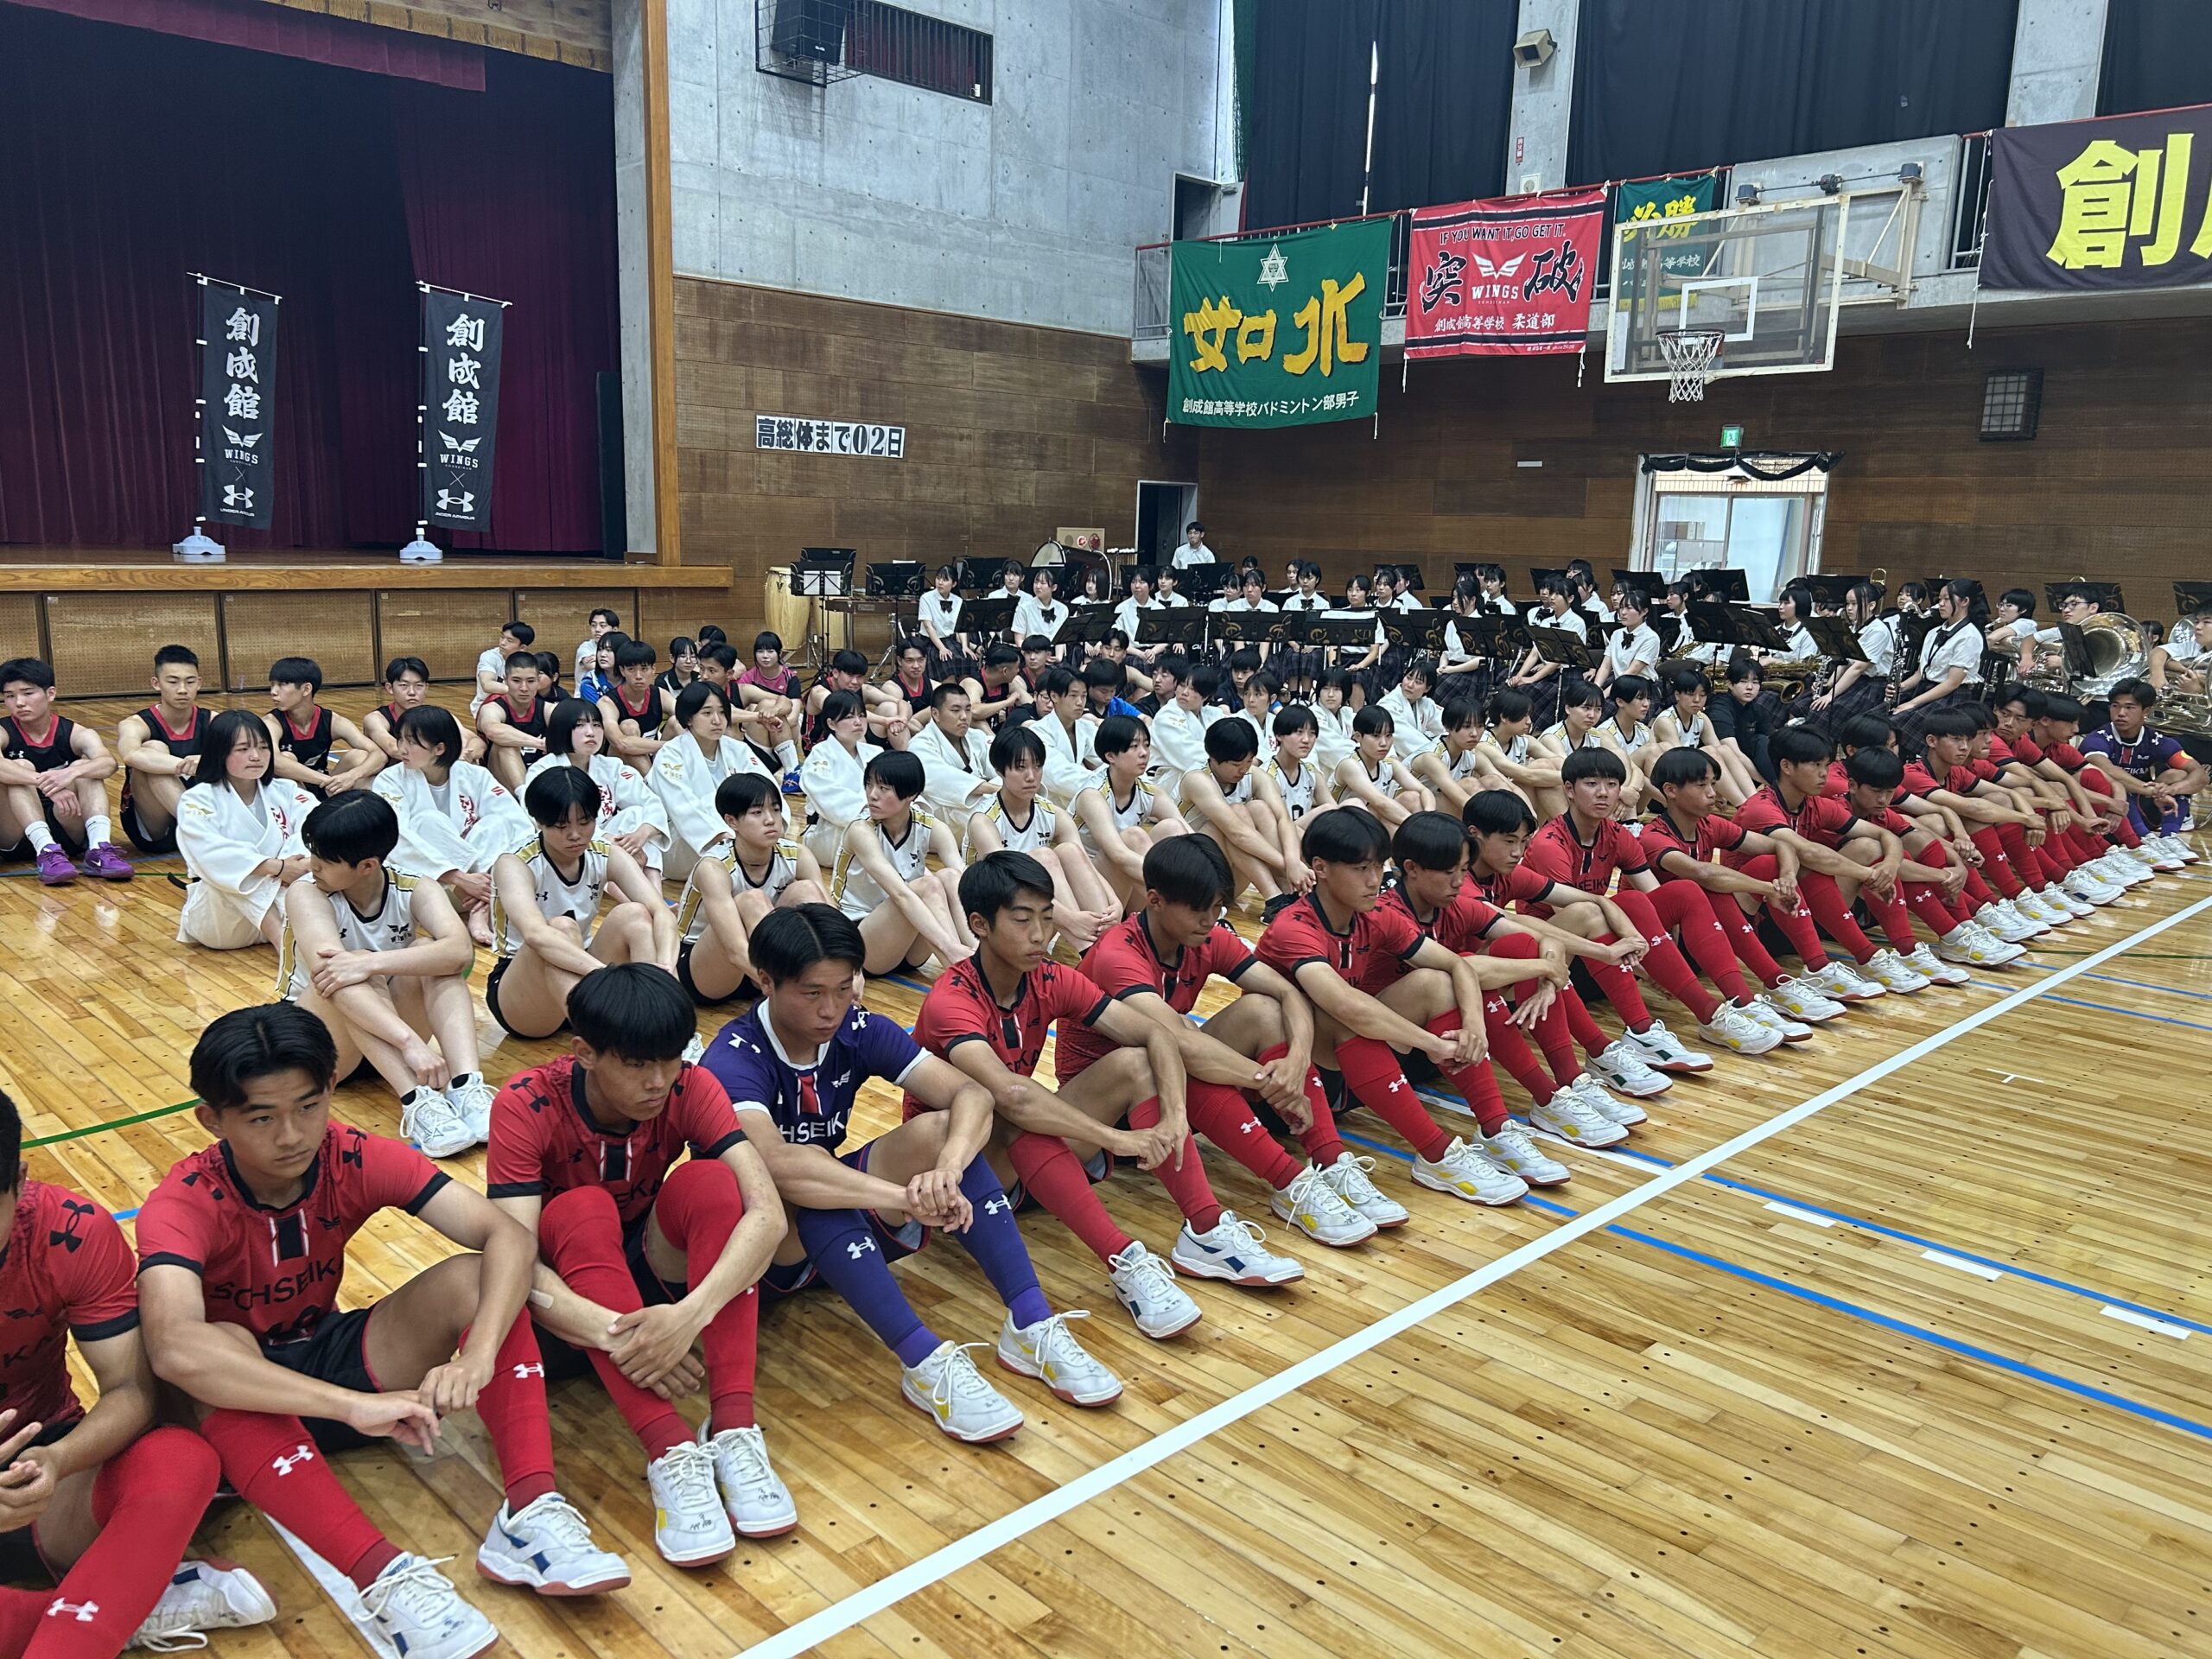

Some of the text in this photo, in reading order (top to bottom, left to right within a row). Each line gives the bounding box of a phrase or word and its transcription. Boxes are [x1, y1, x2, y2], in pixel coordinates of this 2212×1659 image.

[2045, 133, 2212, 270] 創
[1440, 232, 1449, 245] IF
[1452, 227, 1469, 244] YOU
[1472, 226, 1500, 241] WANT
[1532, 225, 1552, 238] GET
[1471, 284, 1519, 300] WINGS
[1512, 313, 1555, 330] 柔道部
[223, 307, 261, 421] 創成館
[442, 313, 485, 425] 創成館
[1182, 391, 1359, 416] 創成館高等学校バドミントン部男子
[757, 417, 903, 457] 高総体まで02日
[225, 449, 258, 465] WINGS
[440, 454, 479, 468] WINGS
